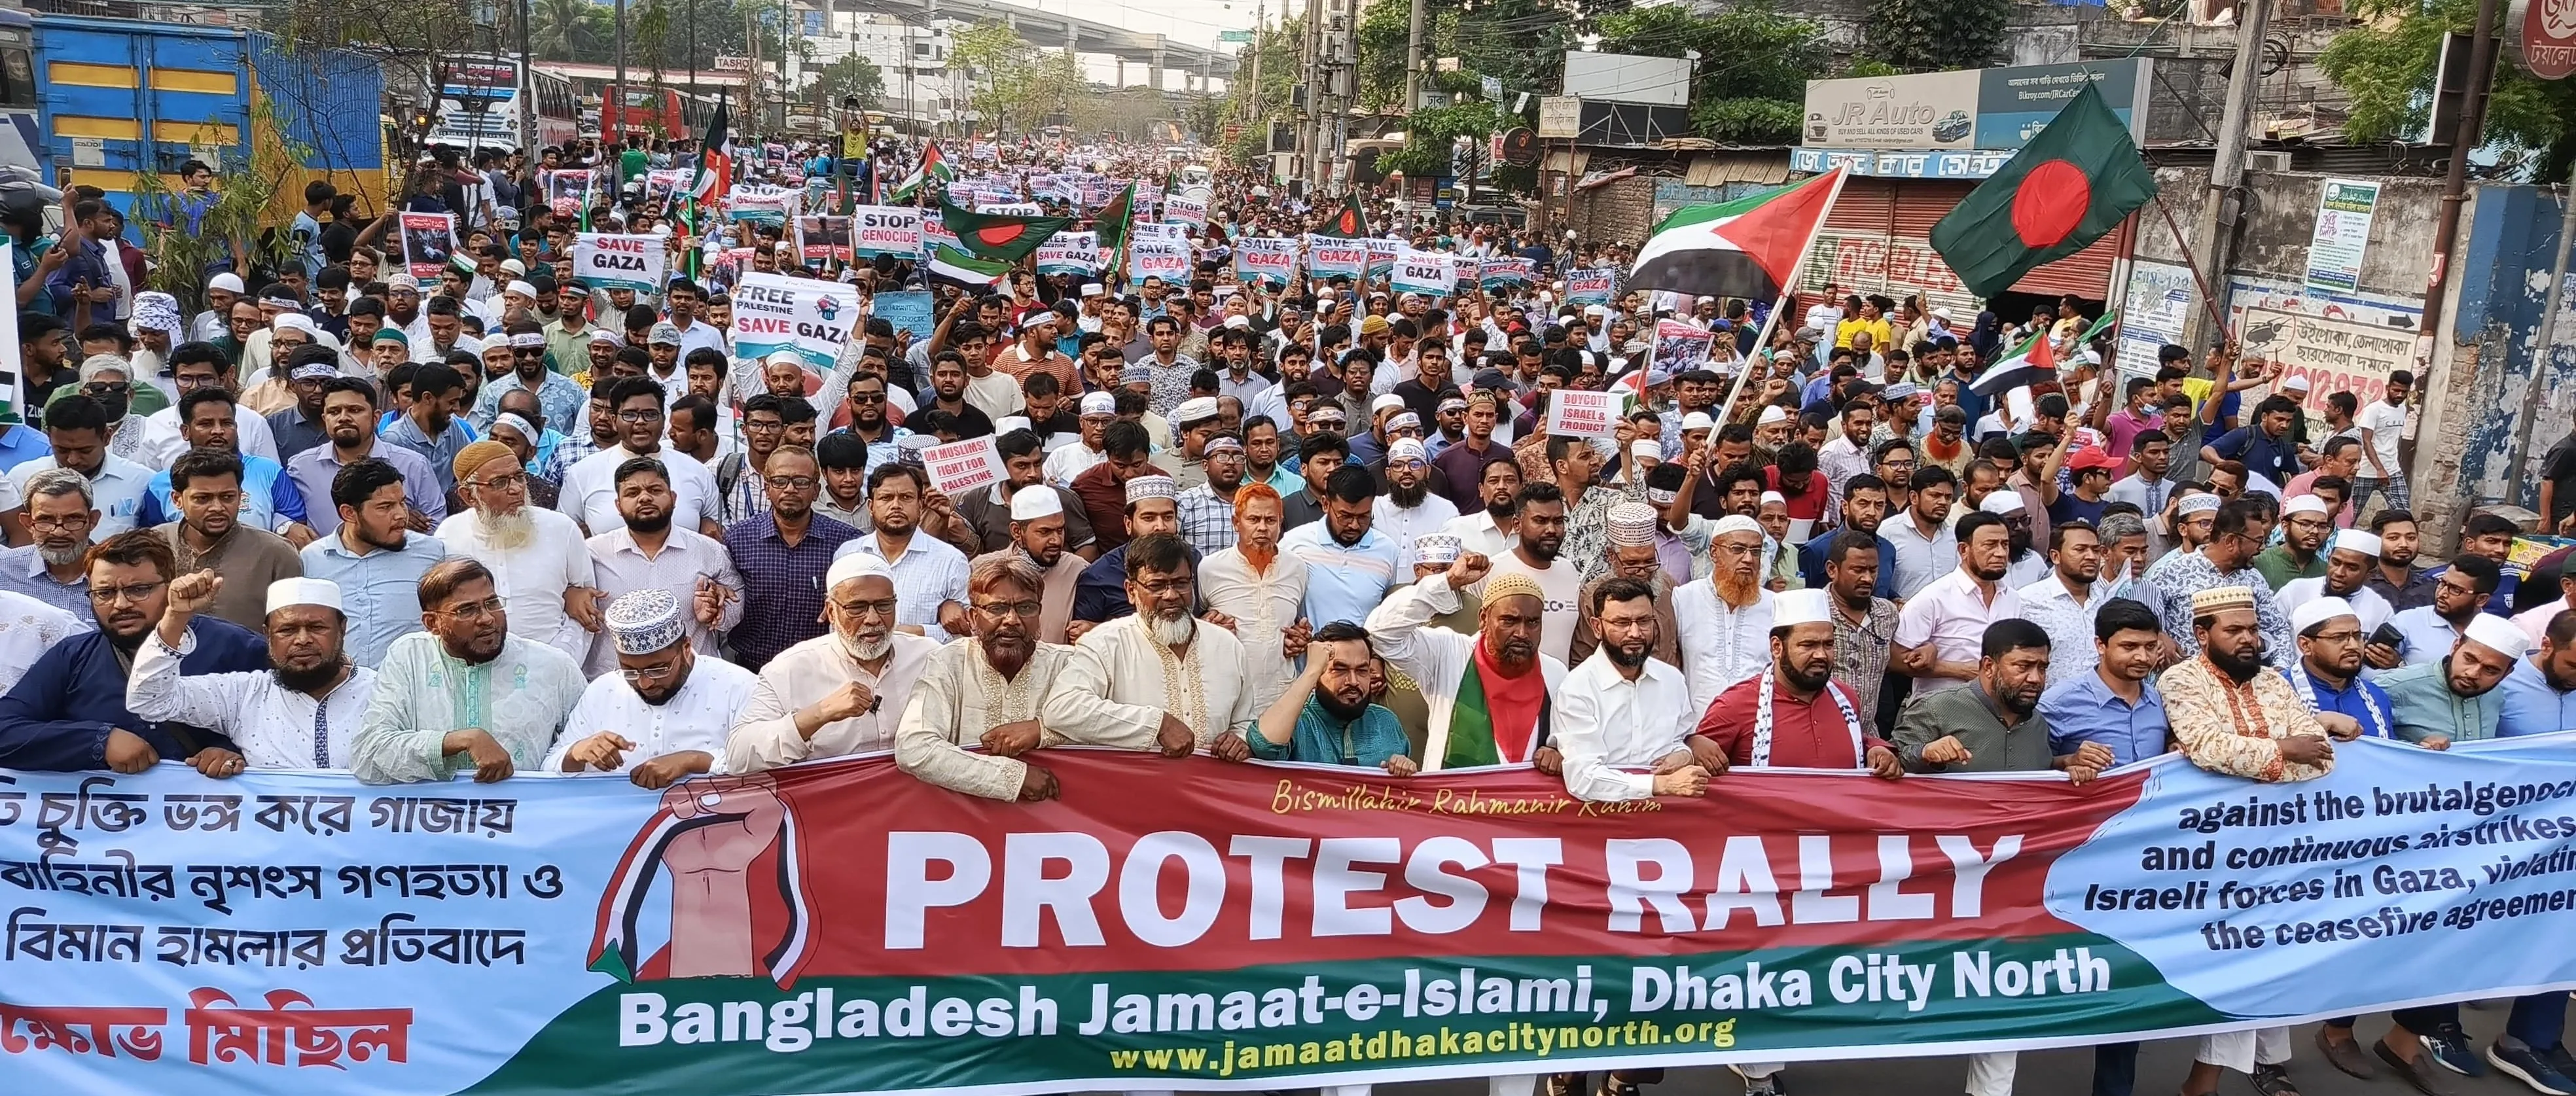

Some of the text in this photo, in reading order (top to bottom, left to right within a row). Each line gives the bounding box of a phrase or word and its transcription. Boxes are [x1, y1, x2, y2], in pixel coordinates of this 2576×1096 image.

[1832, 100, 1935, 125] JR Auto
[1877, 154, 1931, 175] কার
[1939, 153, 2014, 177] সেন্ট
[1171, 200, 1203, 211] STOP
[864, 213, 916, 228] STOP
[920, 209, 940, 218] SA
[1168, 209, 1203, 221] GENOCIDE
[862, 229, 918, 243] GENOCIDE
[1136, 224, 1159, 233] FREE
[597, 238, 644, 253] SAVE
[1049, 235, 1067, 243] REE
[1244, 238, 1281, 251] SAVE
[1315, 238, 1350, 247] SAVE
[1370, 242, 1396, 251] AVE
[1038, 251, 1096, 262] SAVE GAZA
[1137, 245, 1172, 254] SAVE
[1318, 249, 1361, 262] GAZA
[593, 254, 647, 272] GAZA
[1141, 257, 1185, 270] GAZA
[1247, 253, 1291, 267] GAZA
[1409, 253, 1442, 266] SAVE
[1406, 266, 1442, 281] GAZA
[1488, 262, 1527, 275] GAZA
[1571, 270, 1600, 281] SAVE
[1572, 279, 1609, 291] GAZA
[738, 285, 795, 306] FREE
[736, 301, 793, 315] PALESTINE
[738, 317, 848, 347] SAVE GAZA
[2297, 345, 2352, 367] ছারপোকা
[1564, 393, 1608, 406] BOYCOTT
[1562, 408, 1605, 421] ISRAEL &
[1559, 421, 1606, 432] PRODUCT
[924, 440, 988, 461] OH MUSLIMS!
[936, 457, 986, 476] FIGHT FOR
[940, 470, 993, 491] PALESTINE
[1271, 779, 1421, 813] Bismillahir
[1427, 788, 1571, 817] Rahmanir
[37, 777, 149, 849] চুক্তি
[164, 795, 243, 835] ভঙ্গ
[255, 795, 355, 838] করে
[370, 797, 518, 840] গাজায়
[2178, 793, 2307, 834] against
[2314, 789, 2365, 822] the
[2141, 815, 2576, 871] and continuous airstrikes
[1, 848, 564, 917] বাহিনীর নৃশংস গণহত্যা ও
[884, 830, 2026, 950] PROTEST RALLY
[2084, 880, 2208, 913] Israeli
[2219, 877, 2325, 911] forces
[2334, 869, 2361, 899] in
[2372, 864, 2478, 896] Gaza,
[2201, 922, 2265, 951] the
[2276, 906, 2438, 947] ceasefire
[5, 906, 526, 971] বিমান হামলার প্রতিবাদে
[618, 946, 2111, 1053] Bangladesh Jamaat-e-Islami, Dhaka City North
[0, 986, 413, 1072] ক্ষোভ মিছিল
[1109, 1017, 1736, 1077] www.jamaatdhakacitynorth.org
